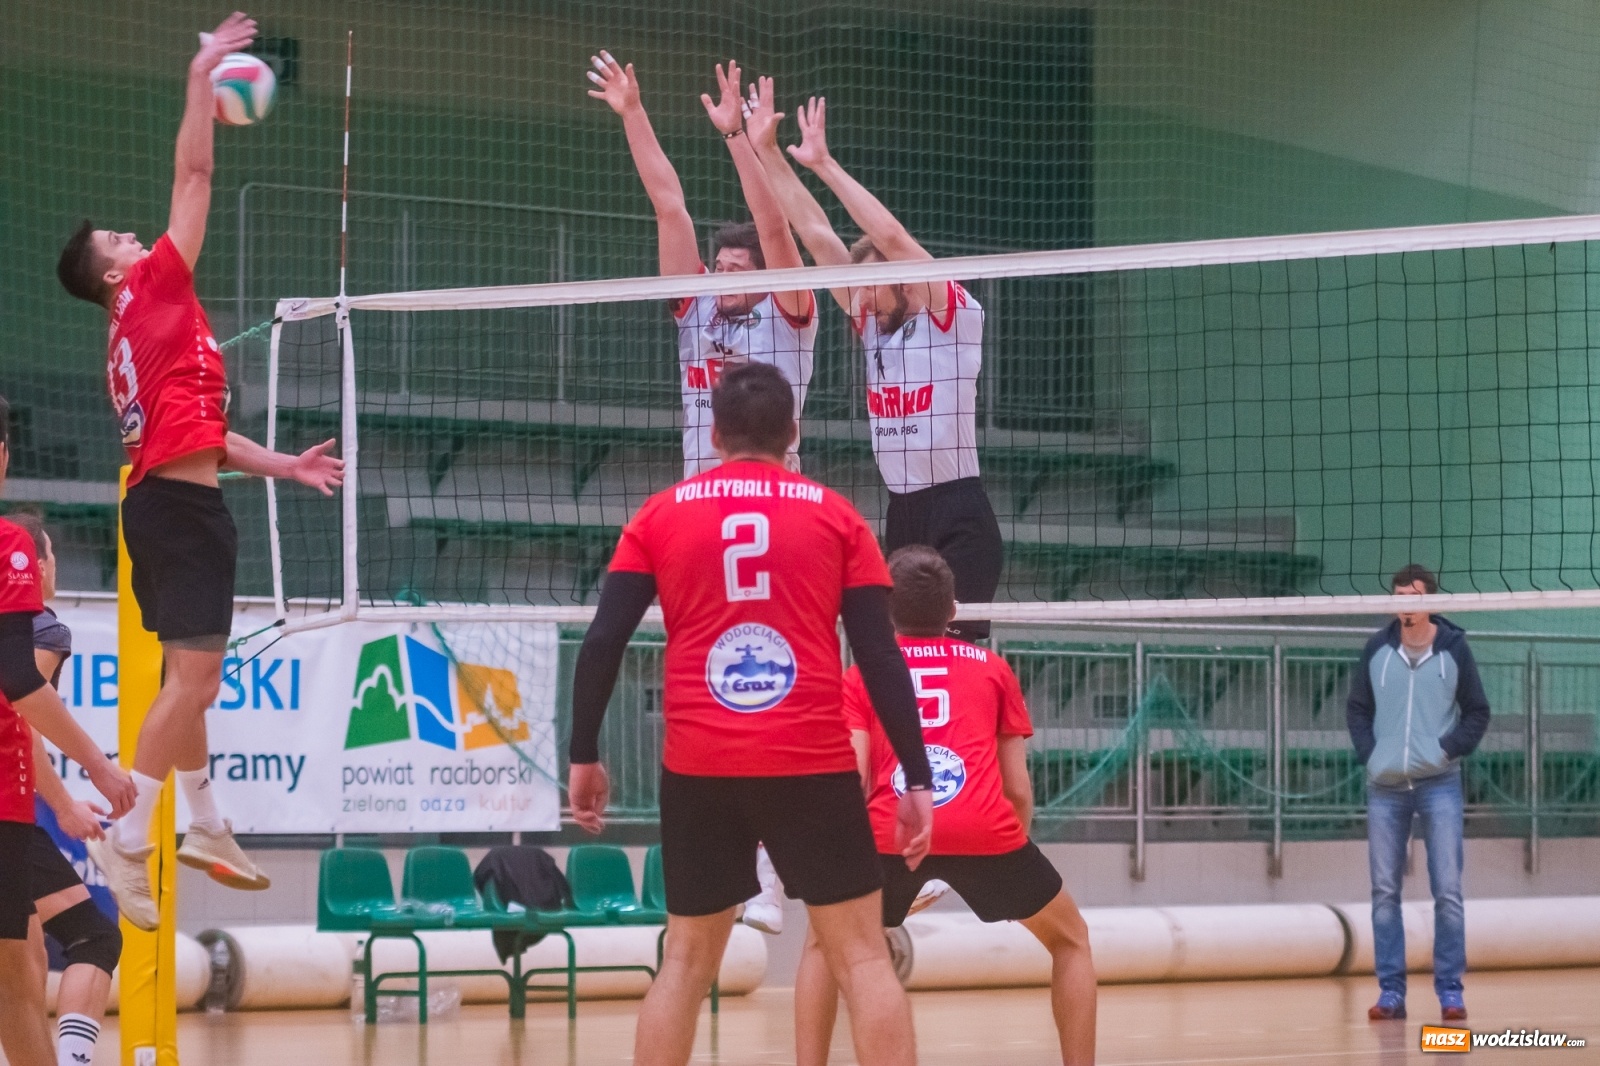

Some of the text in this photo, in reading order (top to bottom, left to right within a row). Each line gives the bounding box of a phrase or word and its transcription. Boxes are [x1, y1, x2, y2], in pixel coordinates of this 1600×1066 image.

[695, 399, 713, 408] GRU
[875, 426, 898, 436] GRUPA
[675, 479, 823, 504] VOLLEYBALL TEAM
[721, 512, 770, 602] 2
[950, 645, 987, 662] TEAM
[909, 667, 949, 727] 5
[342, 758, 532, 793] powiat raciborski
[342, 794, 407, 813] zielona
[420, 798, 466, 812] oaza
